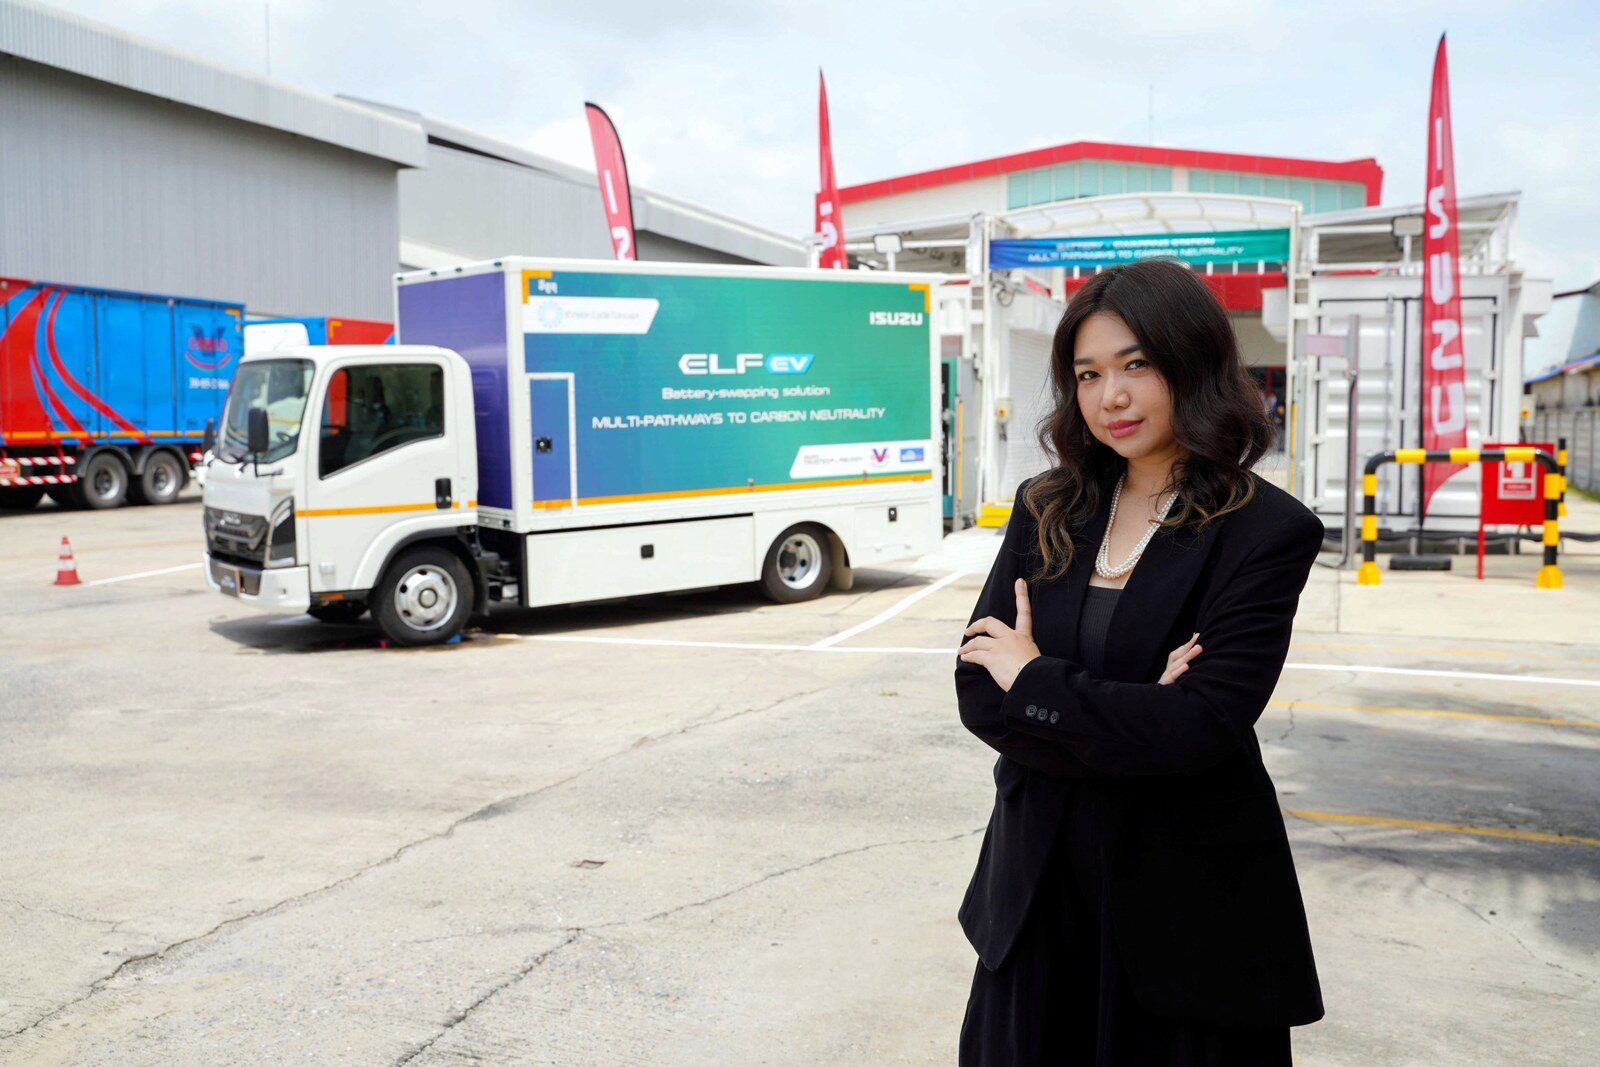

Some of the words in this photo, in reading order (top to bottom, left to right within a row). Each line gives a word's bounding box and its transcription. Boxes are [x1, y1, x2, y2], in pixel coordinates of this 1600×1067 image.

[1428, 117, 1465, 435] ISUZU
[869, 311, 923, 326] ISUZU
[678, 353, 764, 375] ELF
[770, 356, 808, 372] EV
[662, 386, 779, 400] Battery-swapping
[782, 385, 830, 397] solution
[592, 412, 723, 429] MULTI-PATHWAYS
[727, 412, 746, 424] TO
[750, 410, 807, 423] CARBON
[810, 407, 886, 420] NEUTRALITY
